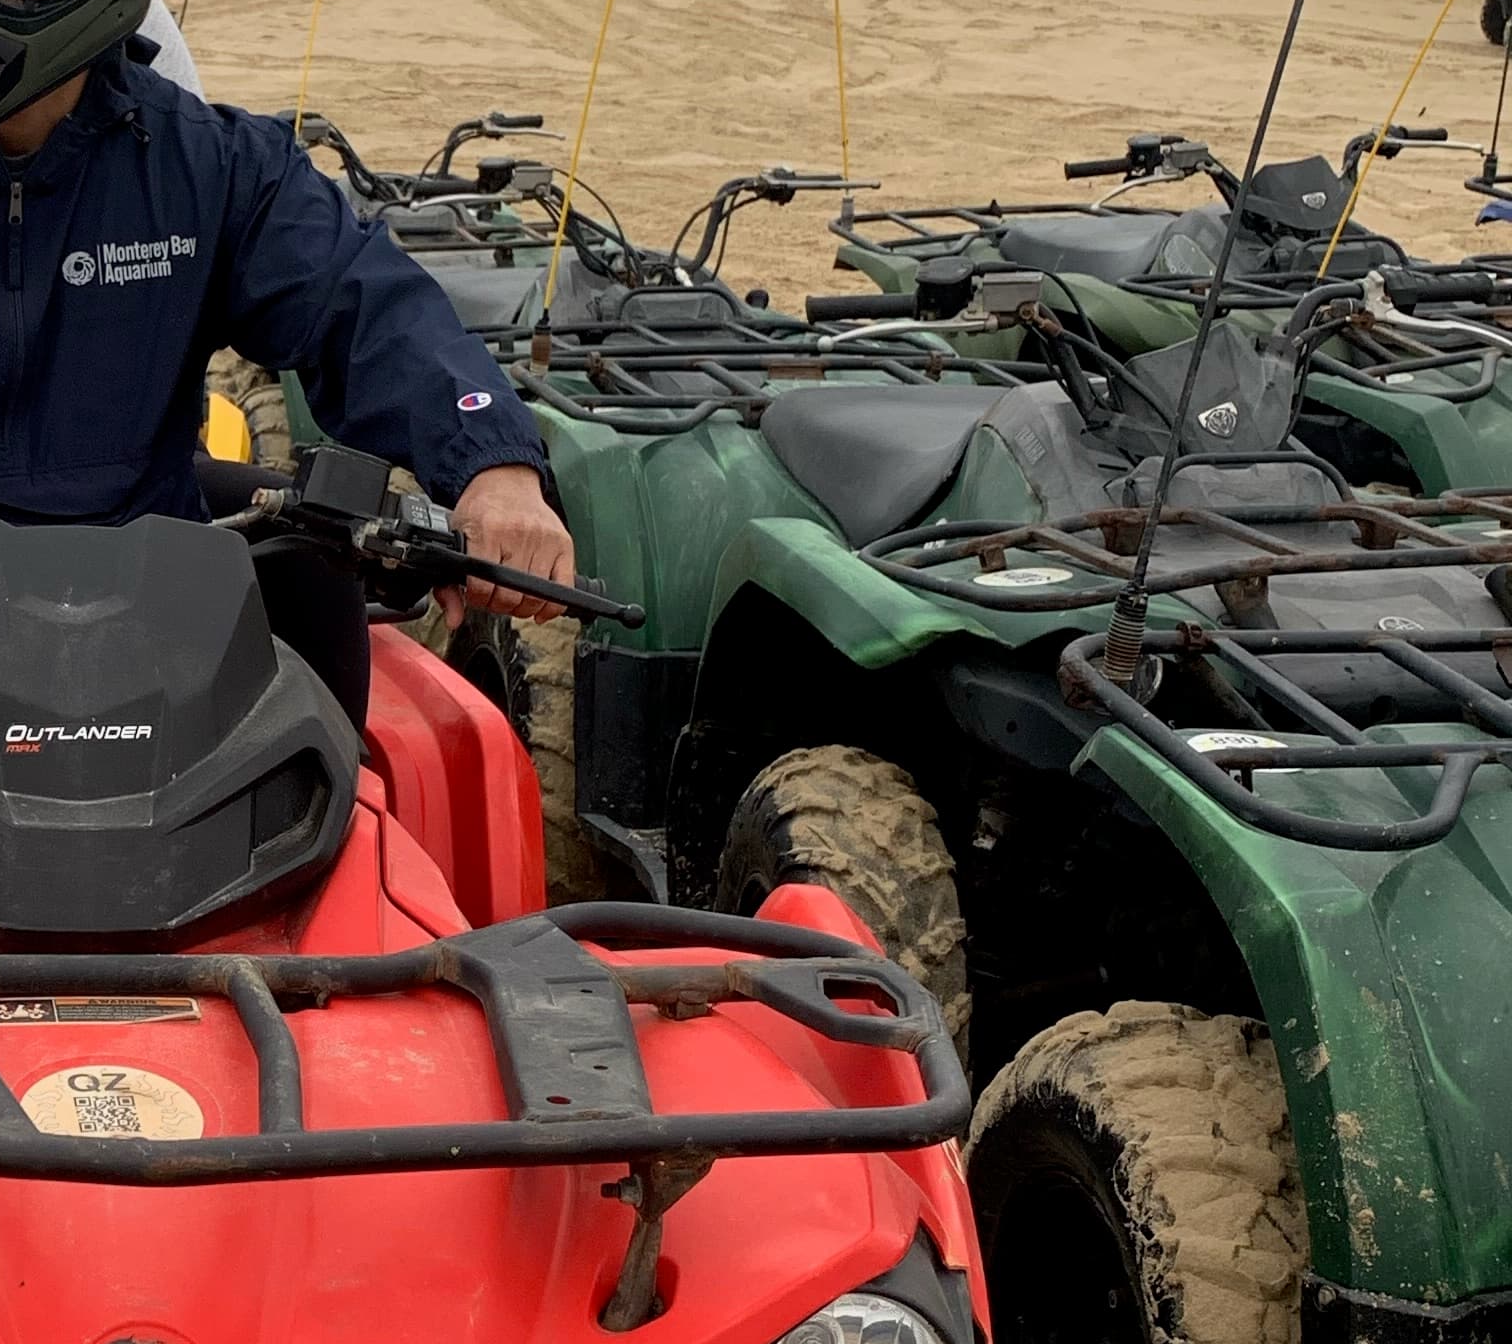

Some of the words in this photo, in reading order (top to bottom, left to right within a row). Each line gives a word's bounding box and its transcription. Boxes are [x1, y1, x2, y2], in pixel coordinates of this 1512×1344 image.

[102, 240, 169, 264] Monterey
[170, 235, 196, 258] Bay
[104, 259, 172, 286] Aquarium
[5, 724, 152, 742] OUTLANDER
[67, 1072, 130, 1092] QZ
